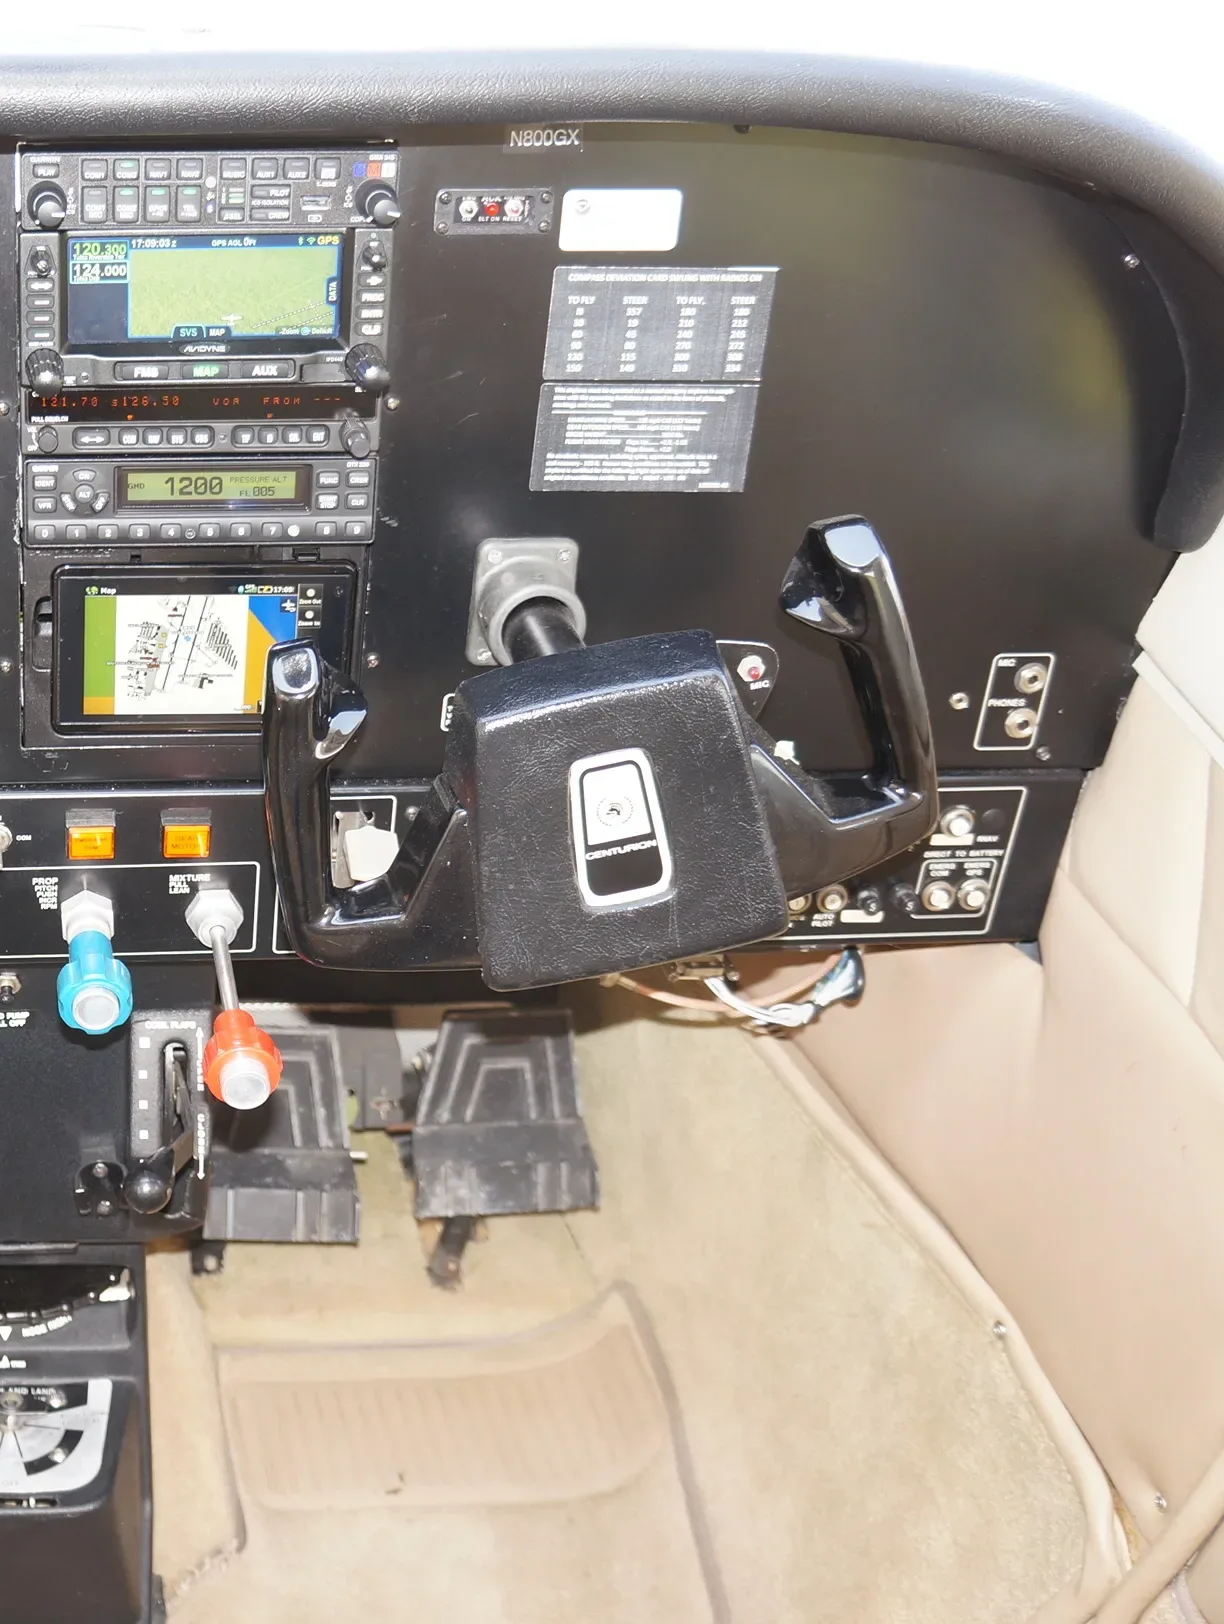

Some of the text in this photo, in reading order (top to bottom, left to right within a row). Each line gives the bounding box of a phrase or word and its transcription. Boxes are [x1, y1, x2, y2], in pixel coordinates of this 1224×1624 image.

[510, 129, 579, 147] N800GX
[317, 236, 340, 245] GPS
[74, 242, 127, 256] 120.300
[74, 263, 127, 277] 124.000
[568, 274, 605, 282] COMPASS
[606, 274, 646, 282] DEVIATION
[647, 274, 668, 282] CARD
[668, 274, 699, 282] SWUNG
[700, 274, 720, 282] WITH
[721, 274, 749, 282] RADIOS
[328, 281, 337, 301] DATA
[361, 293, 384, 302] PROC
[568, 296, 580, 304] TO
[581, 296, 596, 304] FLY
[623, 296, 649, 304] STEER
[676, 296, 688, 304] TO
[731, 296, 757, 304] STEER
[179, 328, 197, 337] SVS
[184, 345, 226, 353] AVIDYNE
[134, 367, 159, 377] FMS
[193, 367, 219, 377] MAP
[252, 365, 278, 376] AUX
[41, 396, 98, 407] 121.70
[263, 397, 300, 405] FROM
[164, 476, 223, 496] 1200
[252, 486, 275, 496] 005
[100, 587, 117, 595] Map
[997, 658, 1016, 667] MIC
[750, 681, 769, 690] MIC
[987, 698, 1026, 707] PHONES
[585, 839, 657, 861] CENTURION
[923, 850, 952, 858] DIRECT
[969, 849, 1005, 857] BATTERY
[32, 877, 59, 885] PROP
[169, 874, 211, 882] MIXTURE
[811, 920, 833, 928] PILOT
[6, 1011, 30, 1019] PUMP
[9, 1019, 26, 1027] OFF
[145, 1021, 197, 1030] COWL FLAPS
